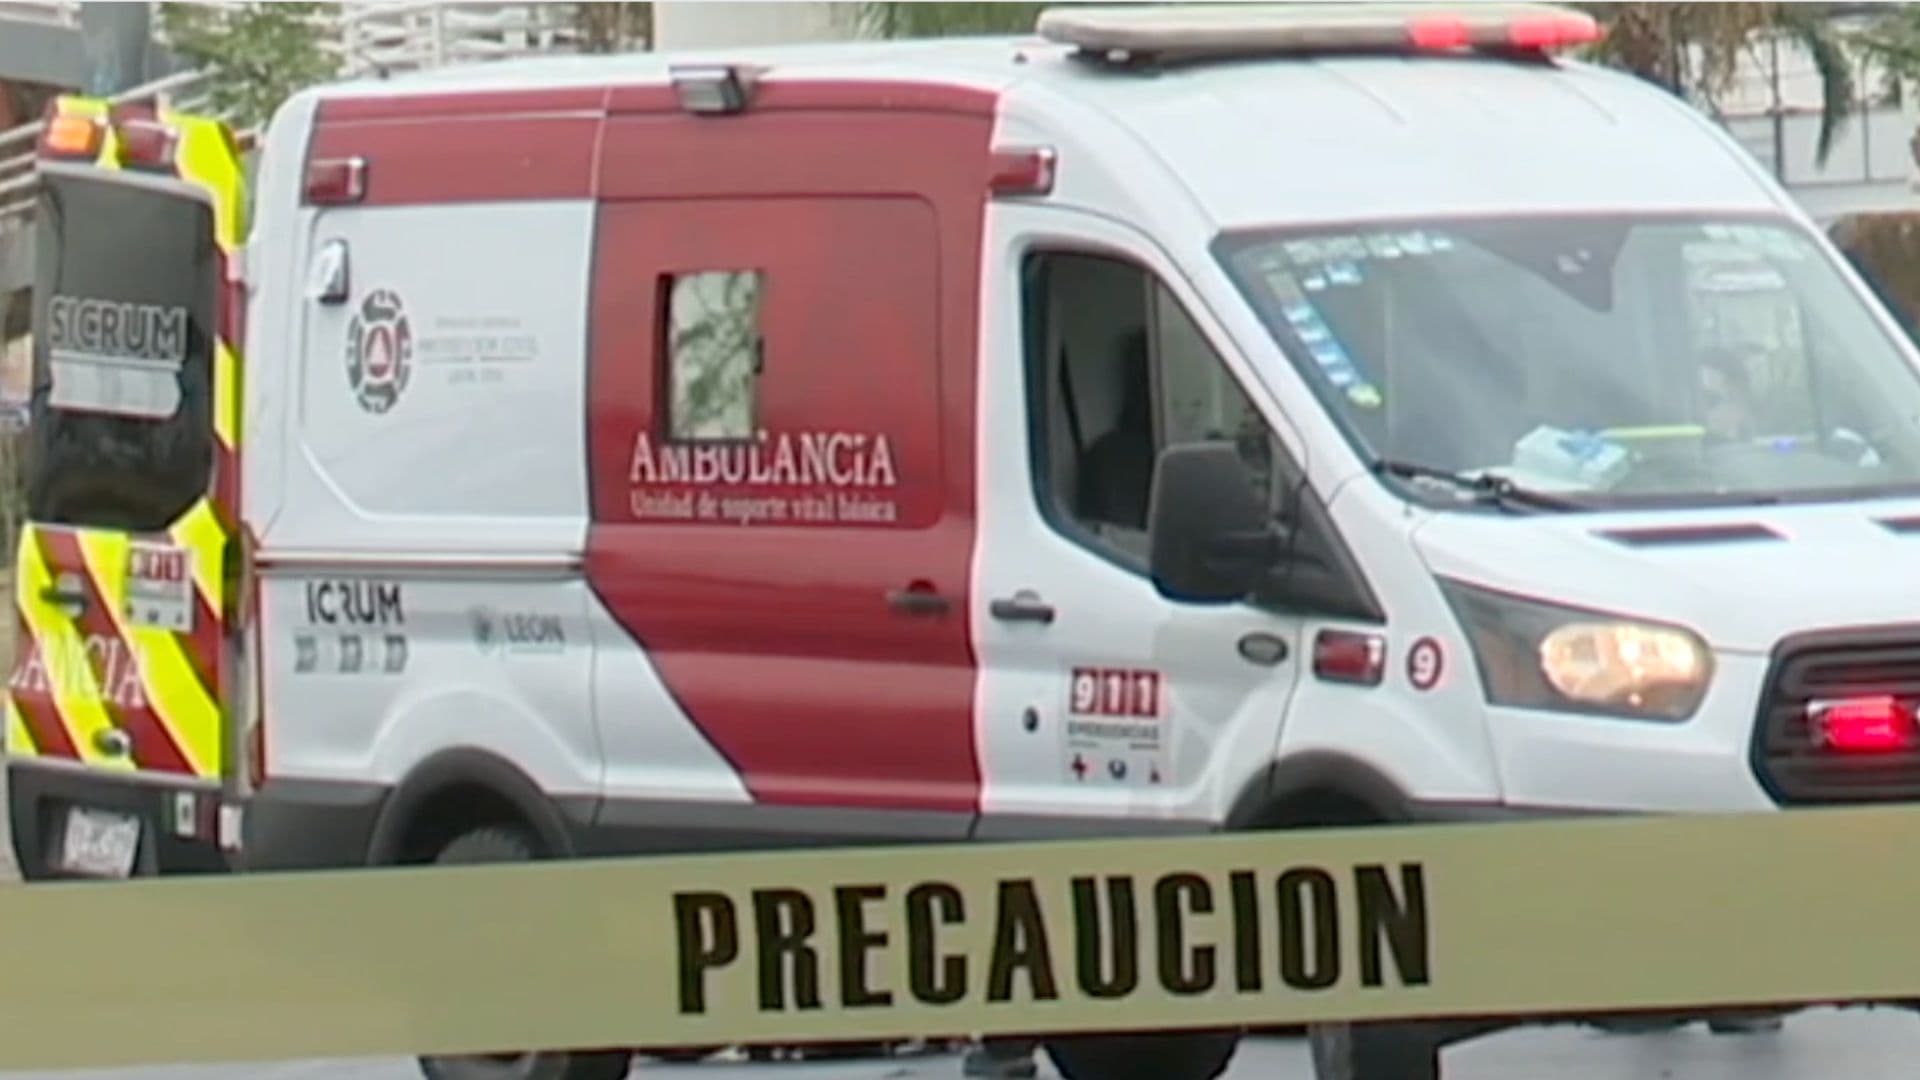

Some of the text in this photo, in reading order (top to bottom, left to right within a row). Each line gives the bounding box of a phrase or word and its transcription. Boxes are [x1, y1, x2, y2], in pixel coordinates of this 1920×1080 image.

[630, 489, 692, 518] Unidad
[697, 489, 717, 518] de
[721, 497, 786, 527] soporte
[788, 493, 833, 520] vital
[1073, 671, 1156, 714] 911
[672, 863, 1431, 1016] PRECAUCION
